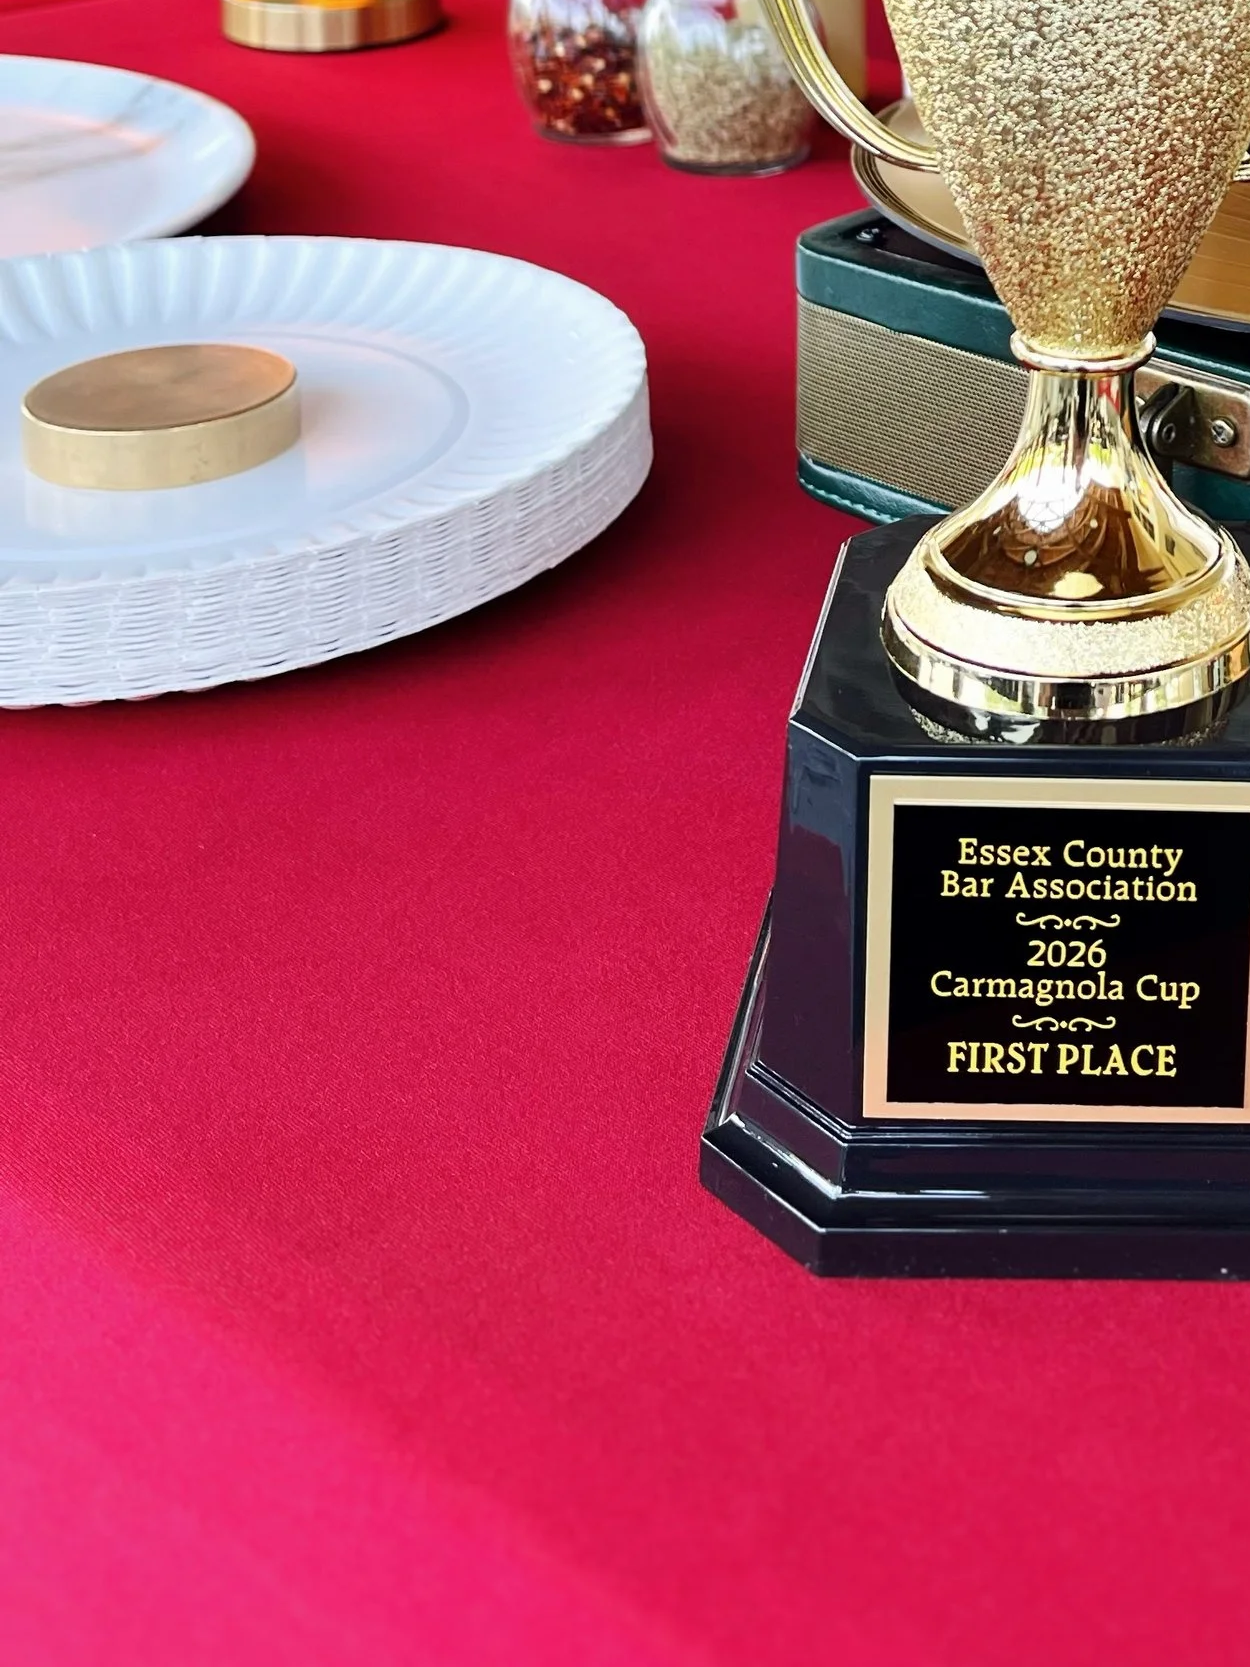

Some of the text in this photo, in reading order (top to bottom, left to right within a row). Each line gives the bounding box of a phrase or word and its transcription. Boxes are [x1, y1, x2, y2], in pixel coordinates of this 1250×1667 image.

[958, 838, 1183, 877] Essex County
[940, 870, 1198, 902] Bar Association
[1027, 939, 1107, 968] 2026
[930, 971, 1200, 1009] Carmagnola Cup
[947, 1041, 1177, 1077] FIRST PLACE
